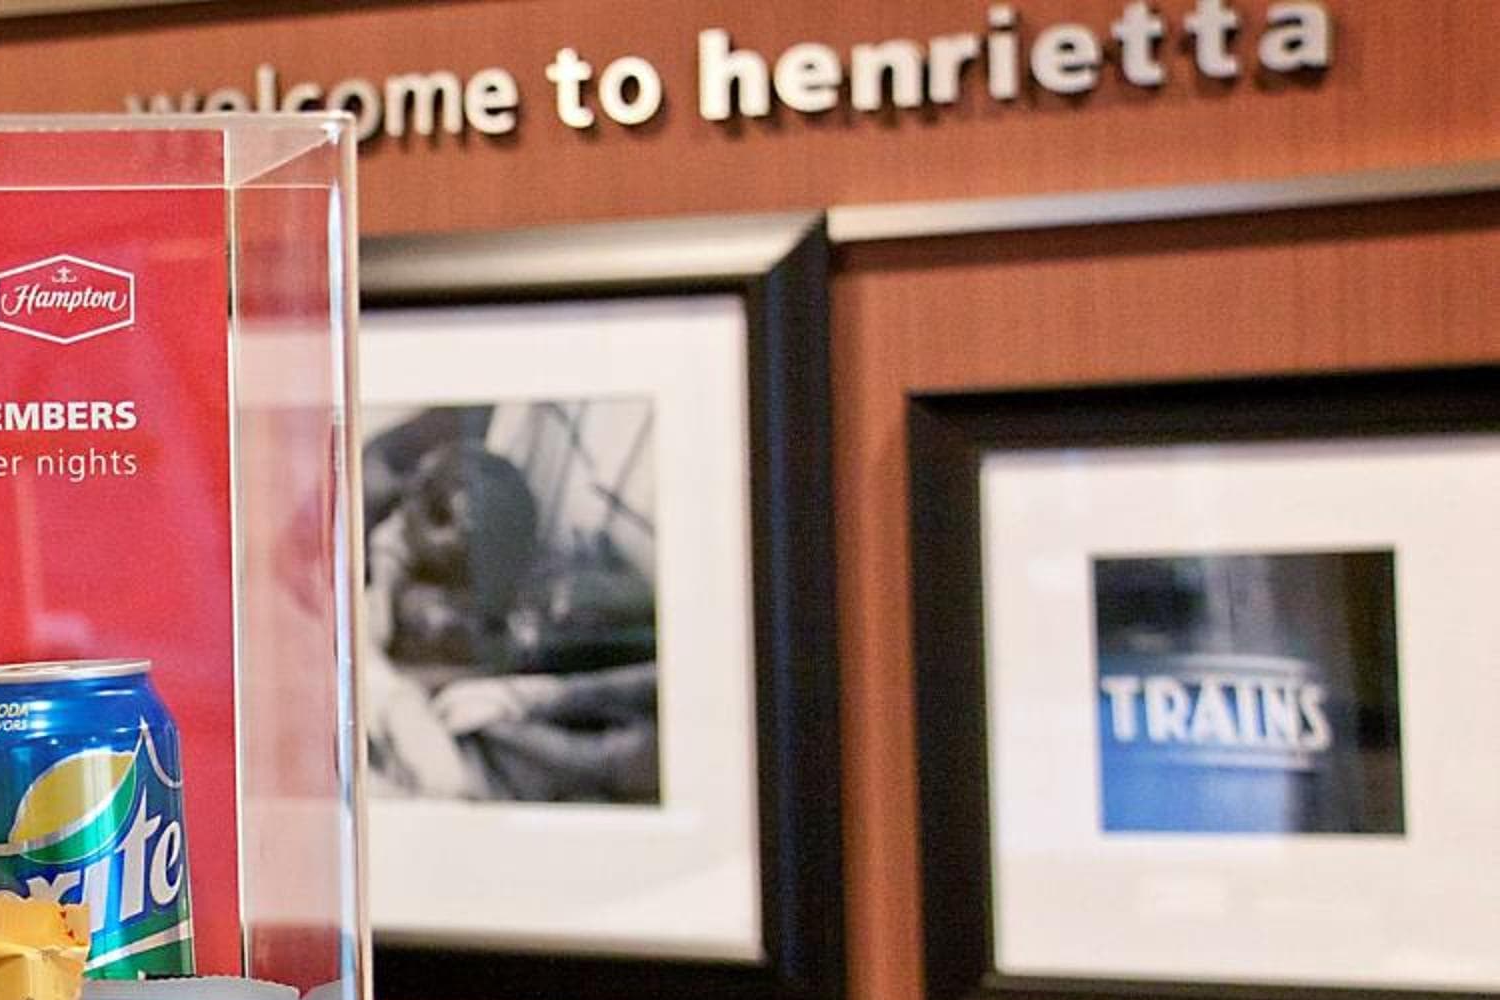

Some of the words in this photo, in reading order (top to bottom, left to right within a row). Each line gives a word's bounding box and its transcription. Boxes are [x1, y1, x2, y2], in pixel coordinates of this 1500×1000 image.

[546, 47, 663, 128] to
[699, 0, 1330, 120] henrietta
[1, 283, 128, 317] Hampton
[37, 447, 138, 484] nights
[1100, 673, 1333, 752] TRAINS
